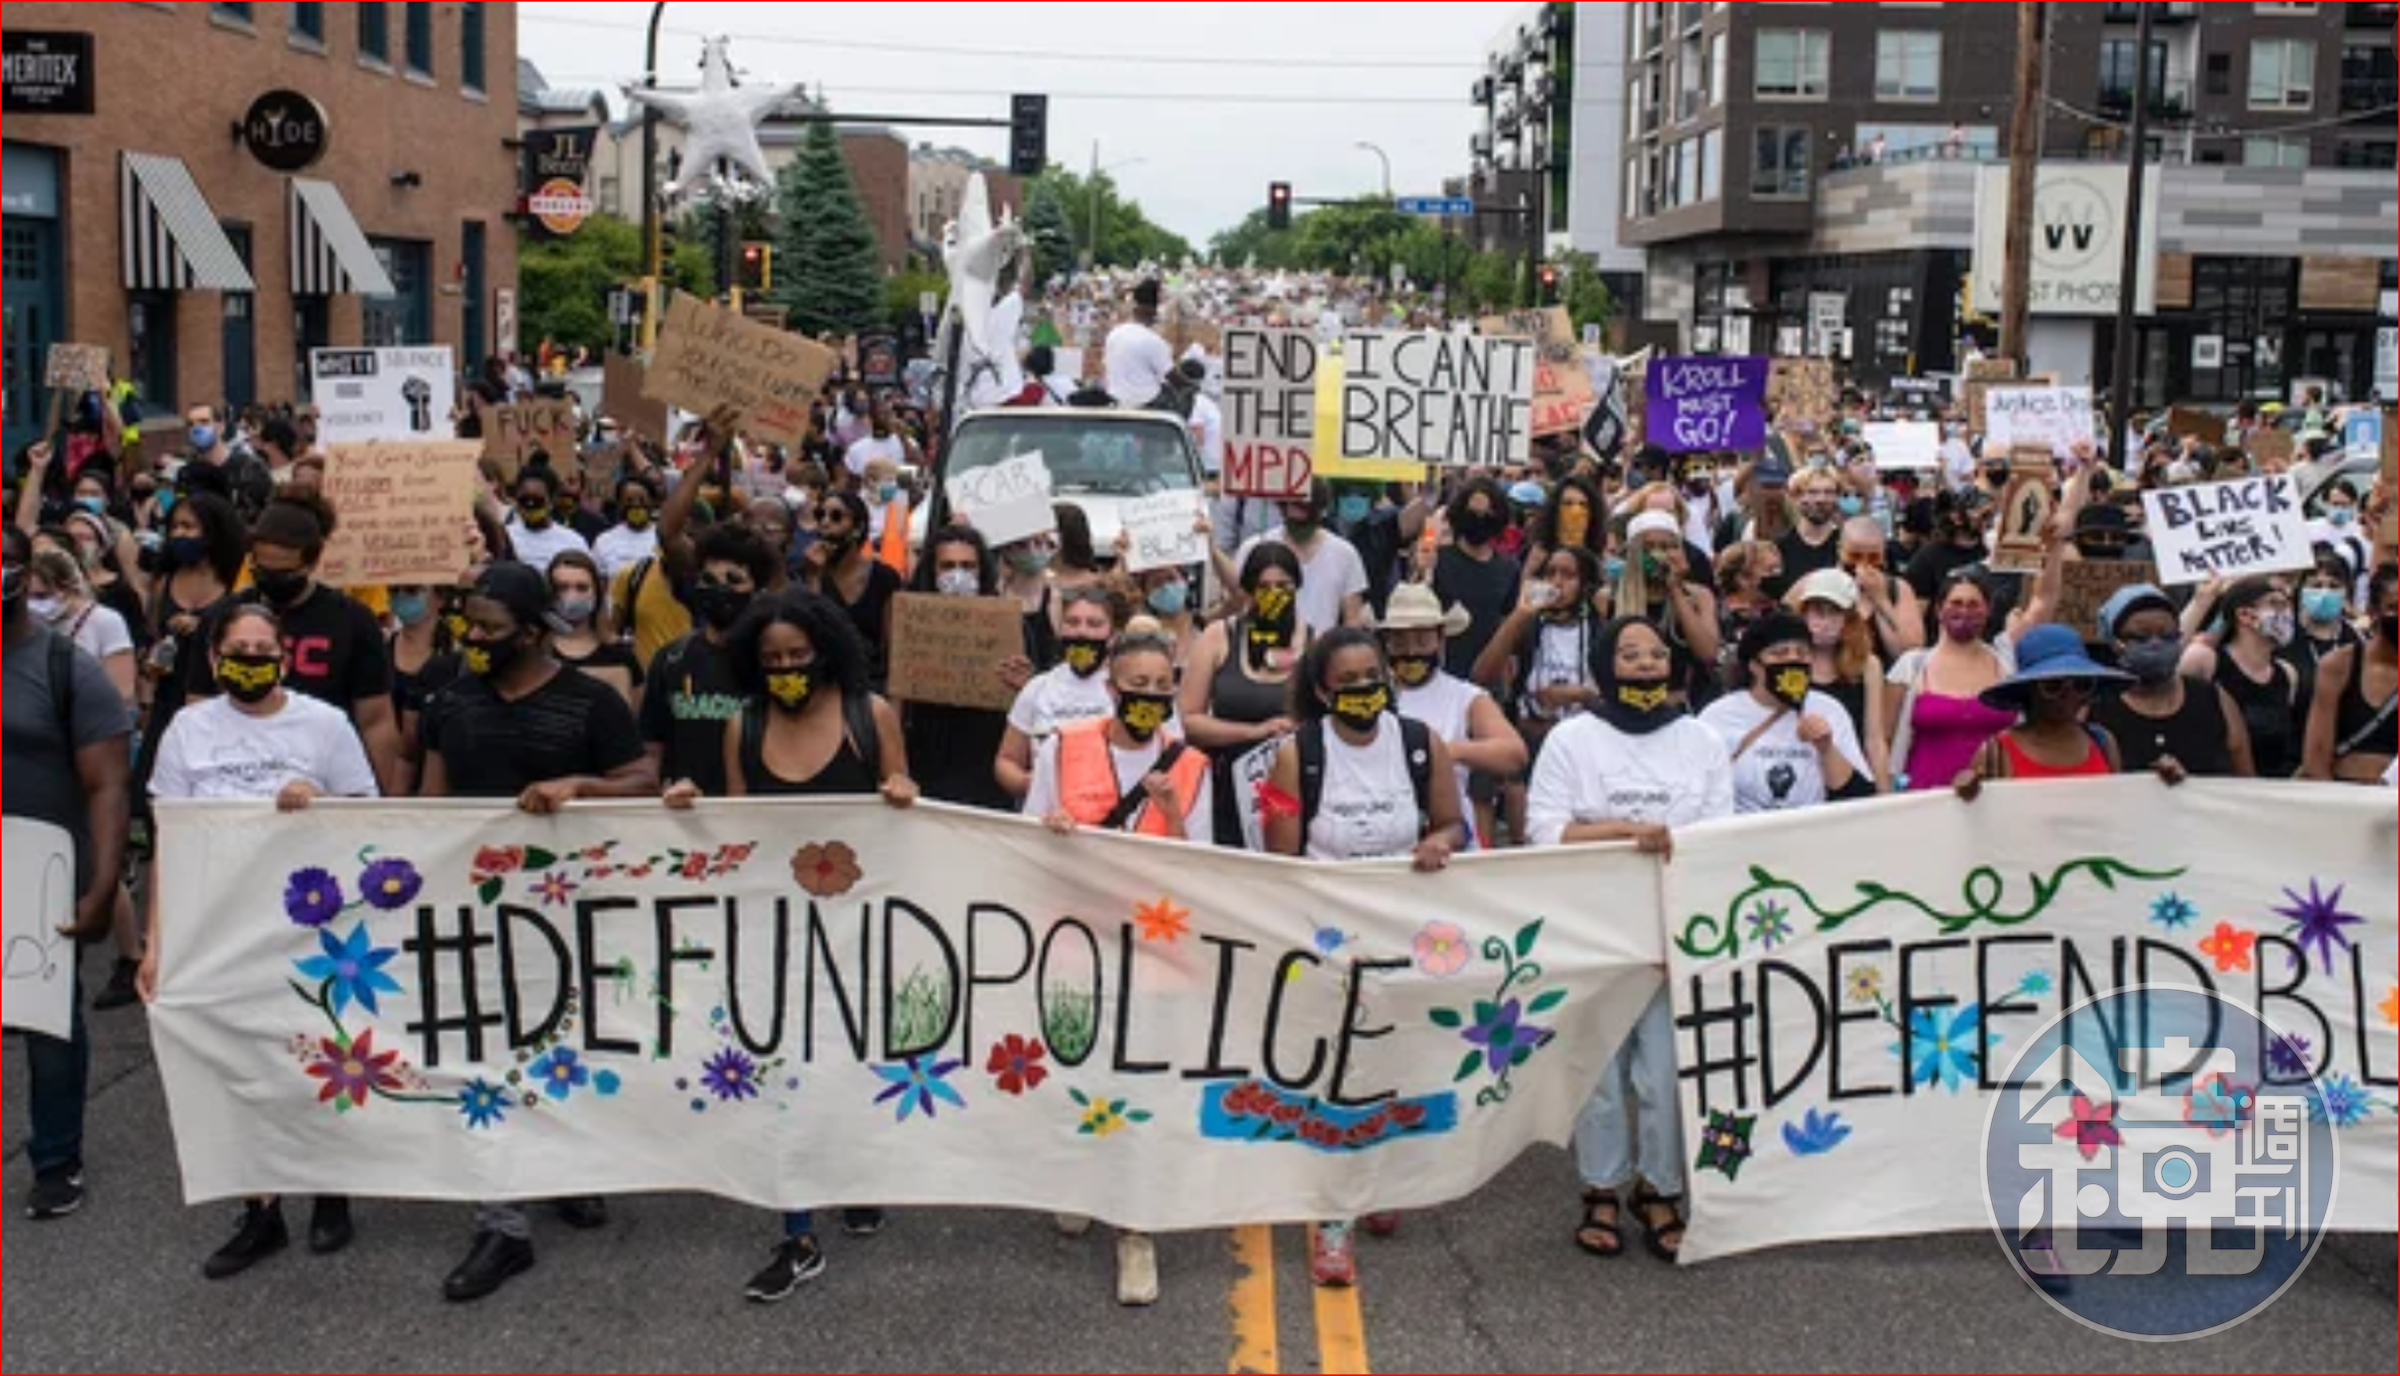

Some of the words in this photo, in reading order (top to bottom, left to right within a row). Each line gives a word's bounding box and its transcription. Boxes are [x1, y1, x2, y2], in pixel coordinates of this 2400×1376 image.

[251, 106, 317, 147] HYDE
[1225, 331, 1316, 383] END
[1346, 334, 1383, 380] I
[1392, 335, 1534, 392] CAN'T
[1661, 363, 1747, 399] KROLL
[1224, 387, 1315, 438] THE
[1342, 386, 1532, 464] BREATHE
[1673, 410, 1738, 447] GO!
[1677, 393, 1735, 415] MUST
[1224, 443, 1312, 497] MPD
[2157, 477, 2291, 530] BLACK
[1676, 934, 2220, 1118] #DEFEND
